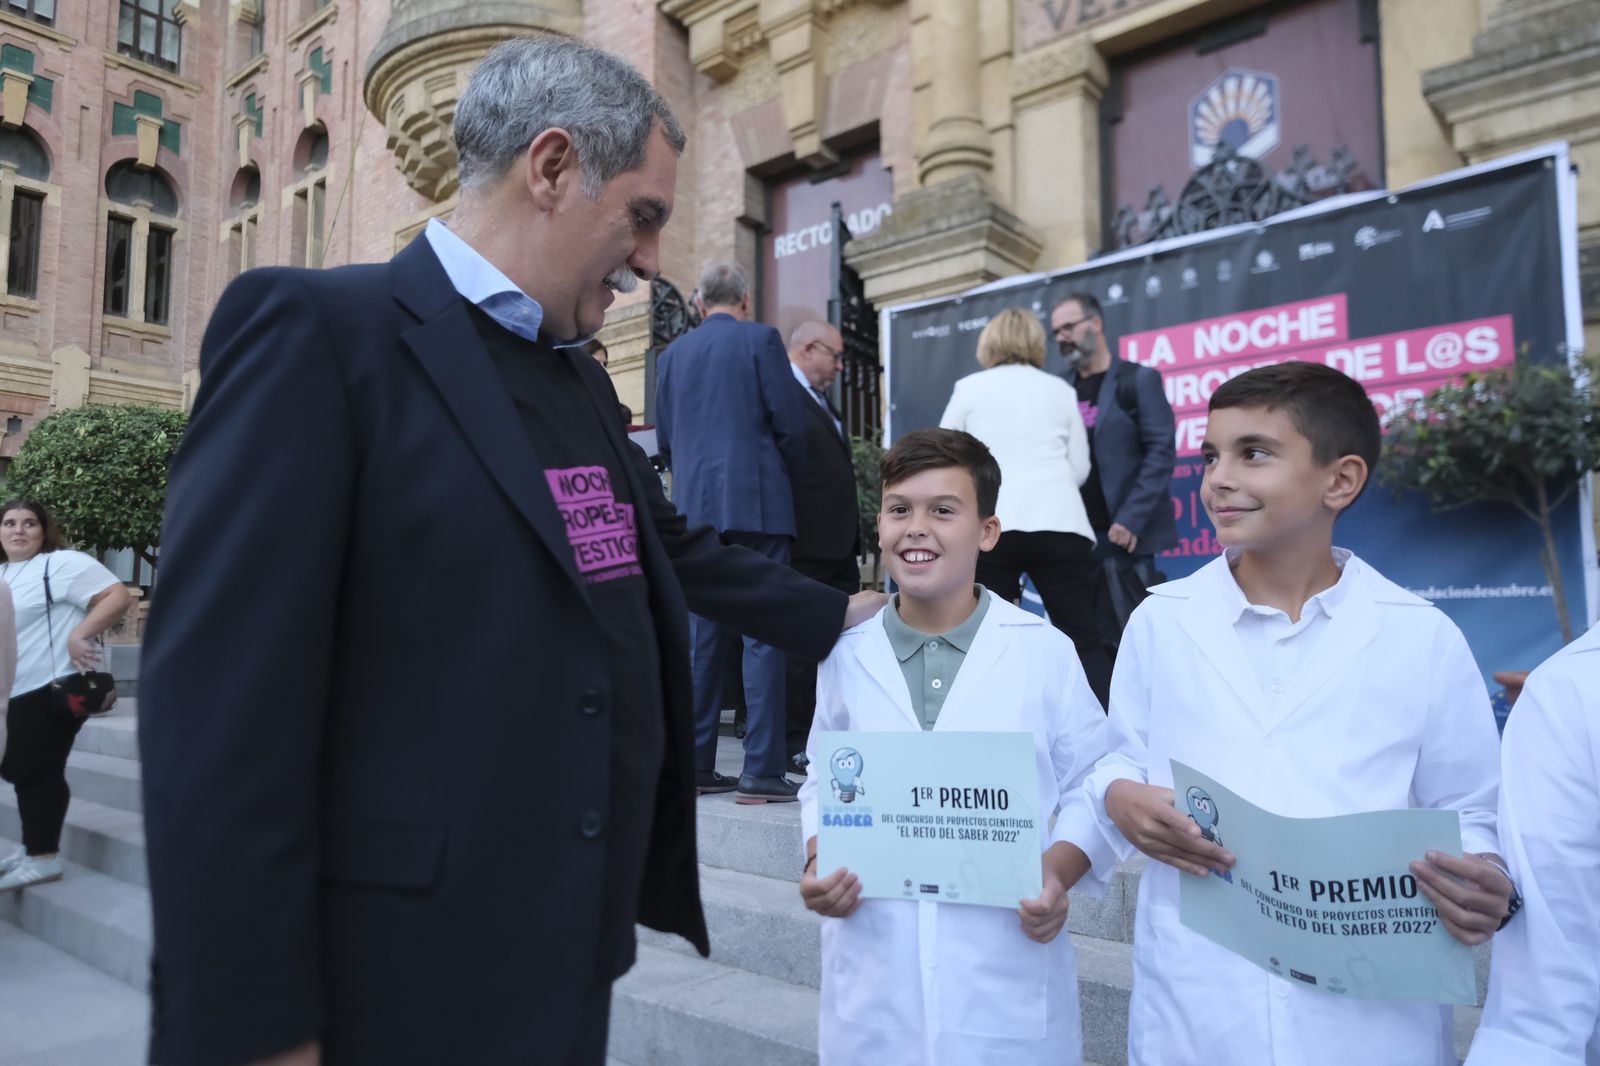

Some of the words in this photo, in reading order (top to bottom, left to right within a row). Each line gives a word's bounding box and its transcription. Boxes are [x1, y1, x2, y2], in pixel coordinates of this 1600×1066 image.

[774, 203, 892, 259] RECTOADO
[1193, 302, 1337, 360] NOCHE
[1395, 326, 1501, 376] L@S
[911, 786, 933, 807] 1ER
[939, 787, 1009, 810] PREMIO
[822, 814, 873, 827] SABER
[881, 813, 895, 824] DEL
[896, 814, 934, 825] CONCURSO
[935, 815, 945, 825] DE
[946, 816, 988, 827] PROYECTOS
[989, 817, 1034, 829] CIENTÍFICOS
[913, 826, 936, 839] RETO
[939, 827, 956, 840] DEL
[958, 828, 988, 841] SABER
[1240, 878, 1253, 894] DEL
[1254, 888, 1303, 916] CONCURSO
[1305, 908, 1320, 919] DE
[1322, 908, 1385, 921] PROYECTOS
[1268, 870, 1300, 894] 1ER
[1309, 874, 1418, 903] PREMIO
[1275, 910, 1307, 930] RETO
[1312, 921, 1337, 936] DEL
[1341, 922, 1388, 936] SABER
